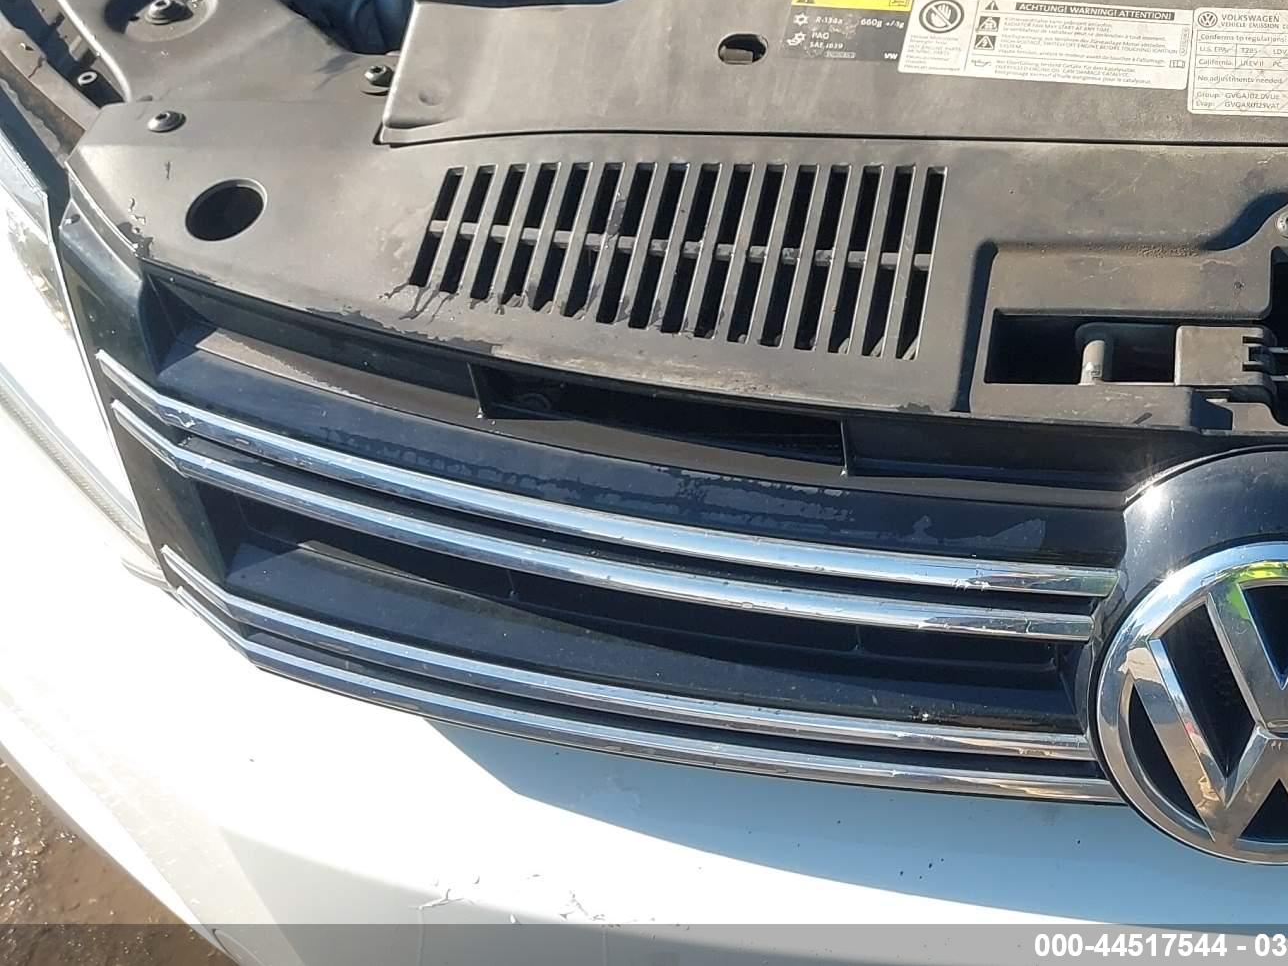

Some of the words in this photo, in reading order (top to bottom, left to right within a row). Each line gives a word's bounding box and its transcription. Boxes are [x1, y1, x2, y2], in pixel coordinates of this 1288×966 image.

[1018, 4, 1068, 14] ACHTUNG!
[1070, 7, 1119, 17] WARNING!
[1119, 10, 1172, 21] ATTENTION!
[1221, 13, 1280, 23] VOLKSWAGEN
[1200, 33, 1234, 42] Conforms
